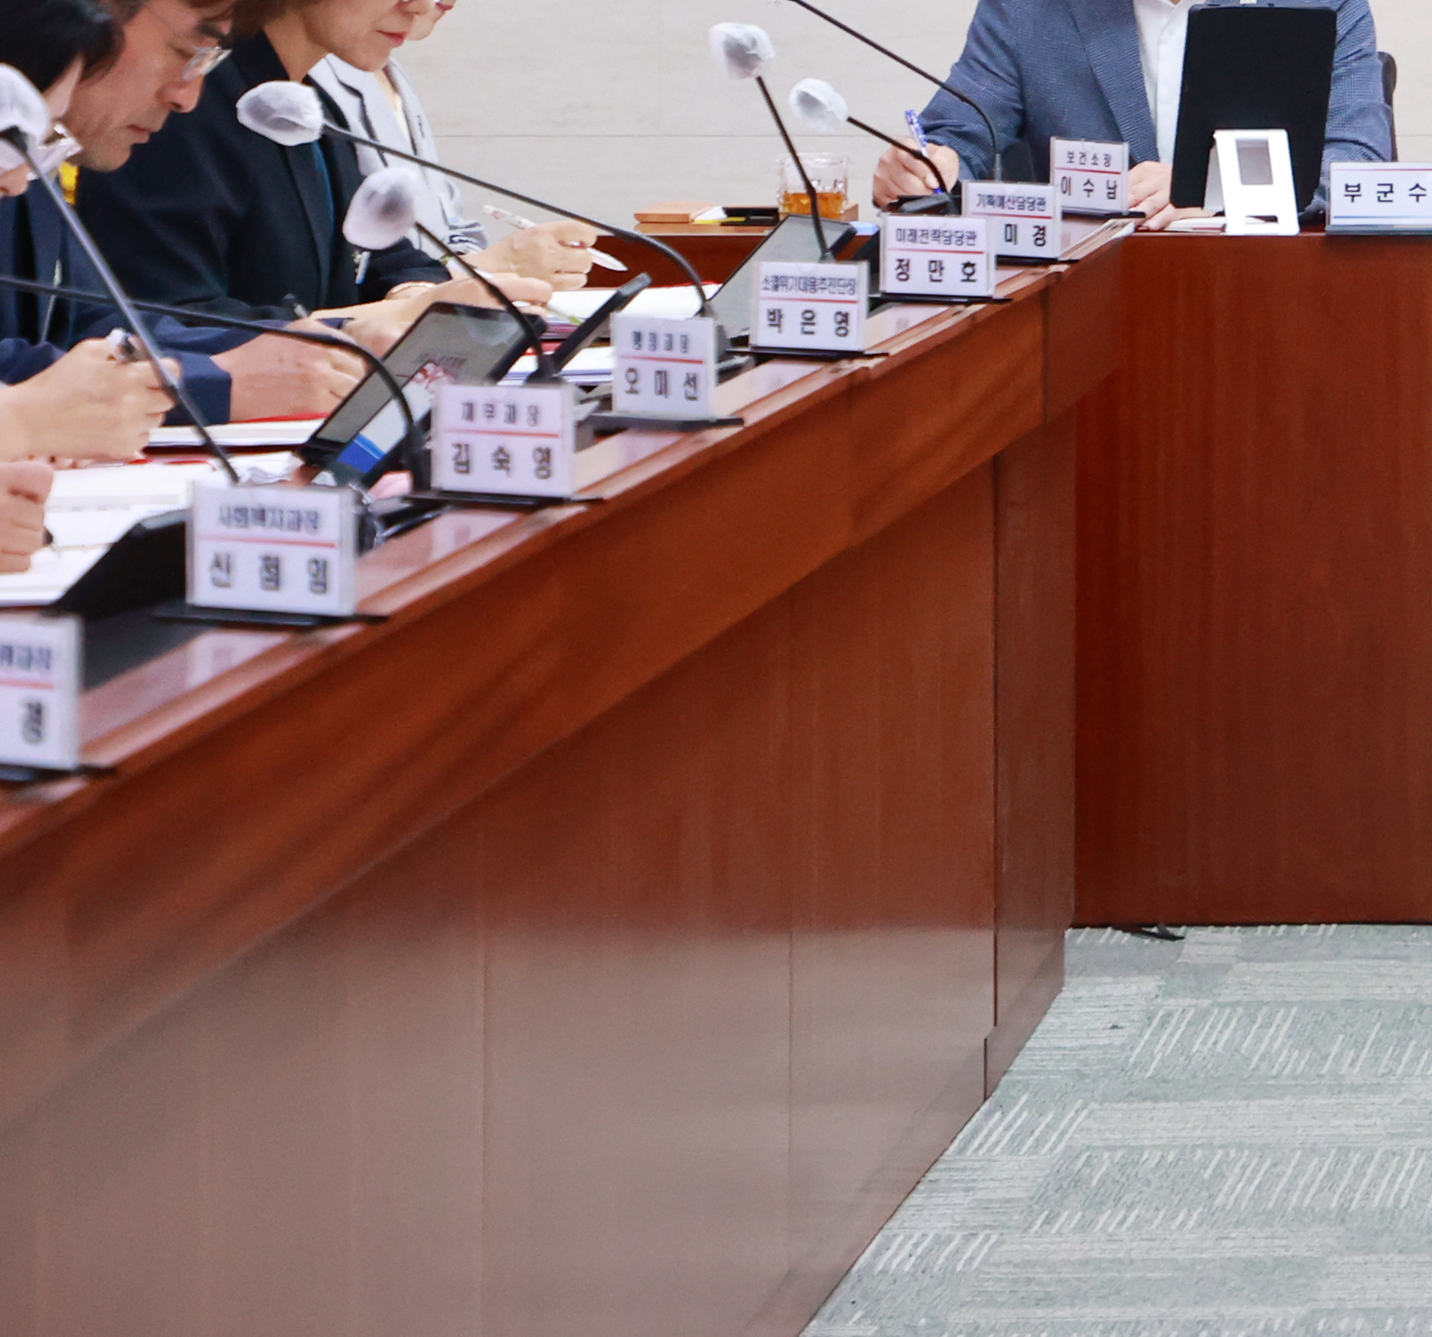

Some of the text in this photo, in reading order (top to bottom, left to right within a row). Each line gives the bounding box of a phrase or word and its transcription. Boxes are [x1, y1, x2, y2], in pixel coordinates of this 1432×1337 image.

[1067, 151, 1112, 168] 보건소장
[1061, 176, 1117, 200] 이수남
[1344, 183, 1427, 203] 부군수
[976, 193, 1046, 212] 기획예산담당관
[896, 228, 977, 246] 미래전략담당관
[1004, 223, 1046, 247] 미경
[895, 259, 977, 282] 정만호
[767, 308, 849, 337] 박은영
